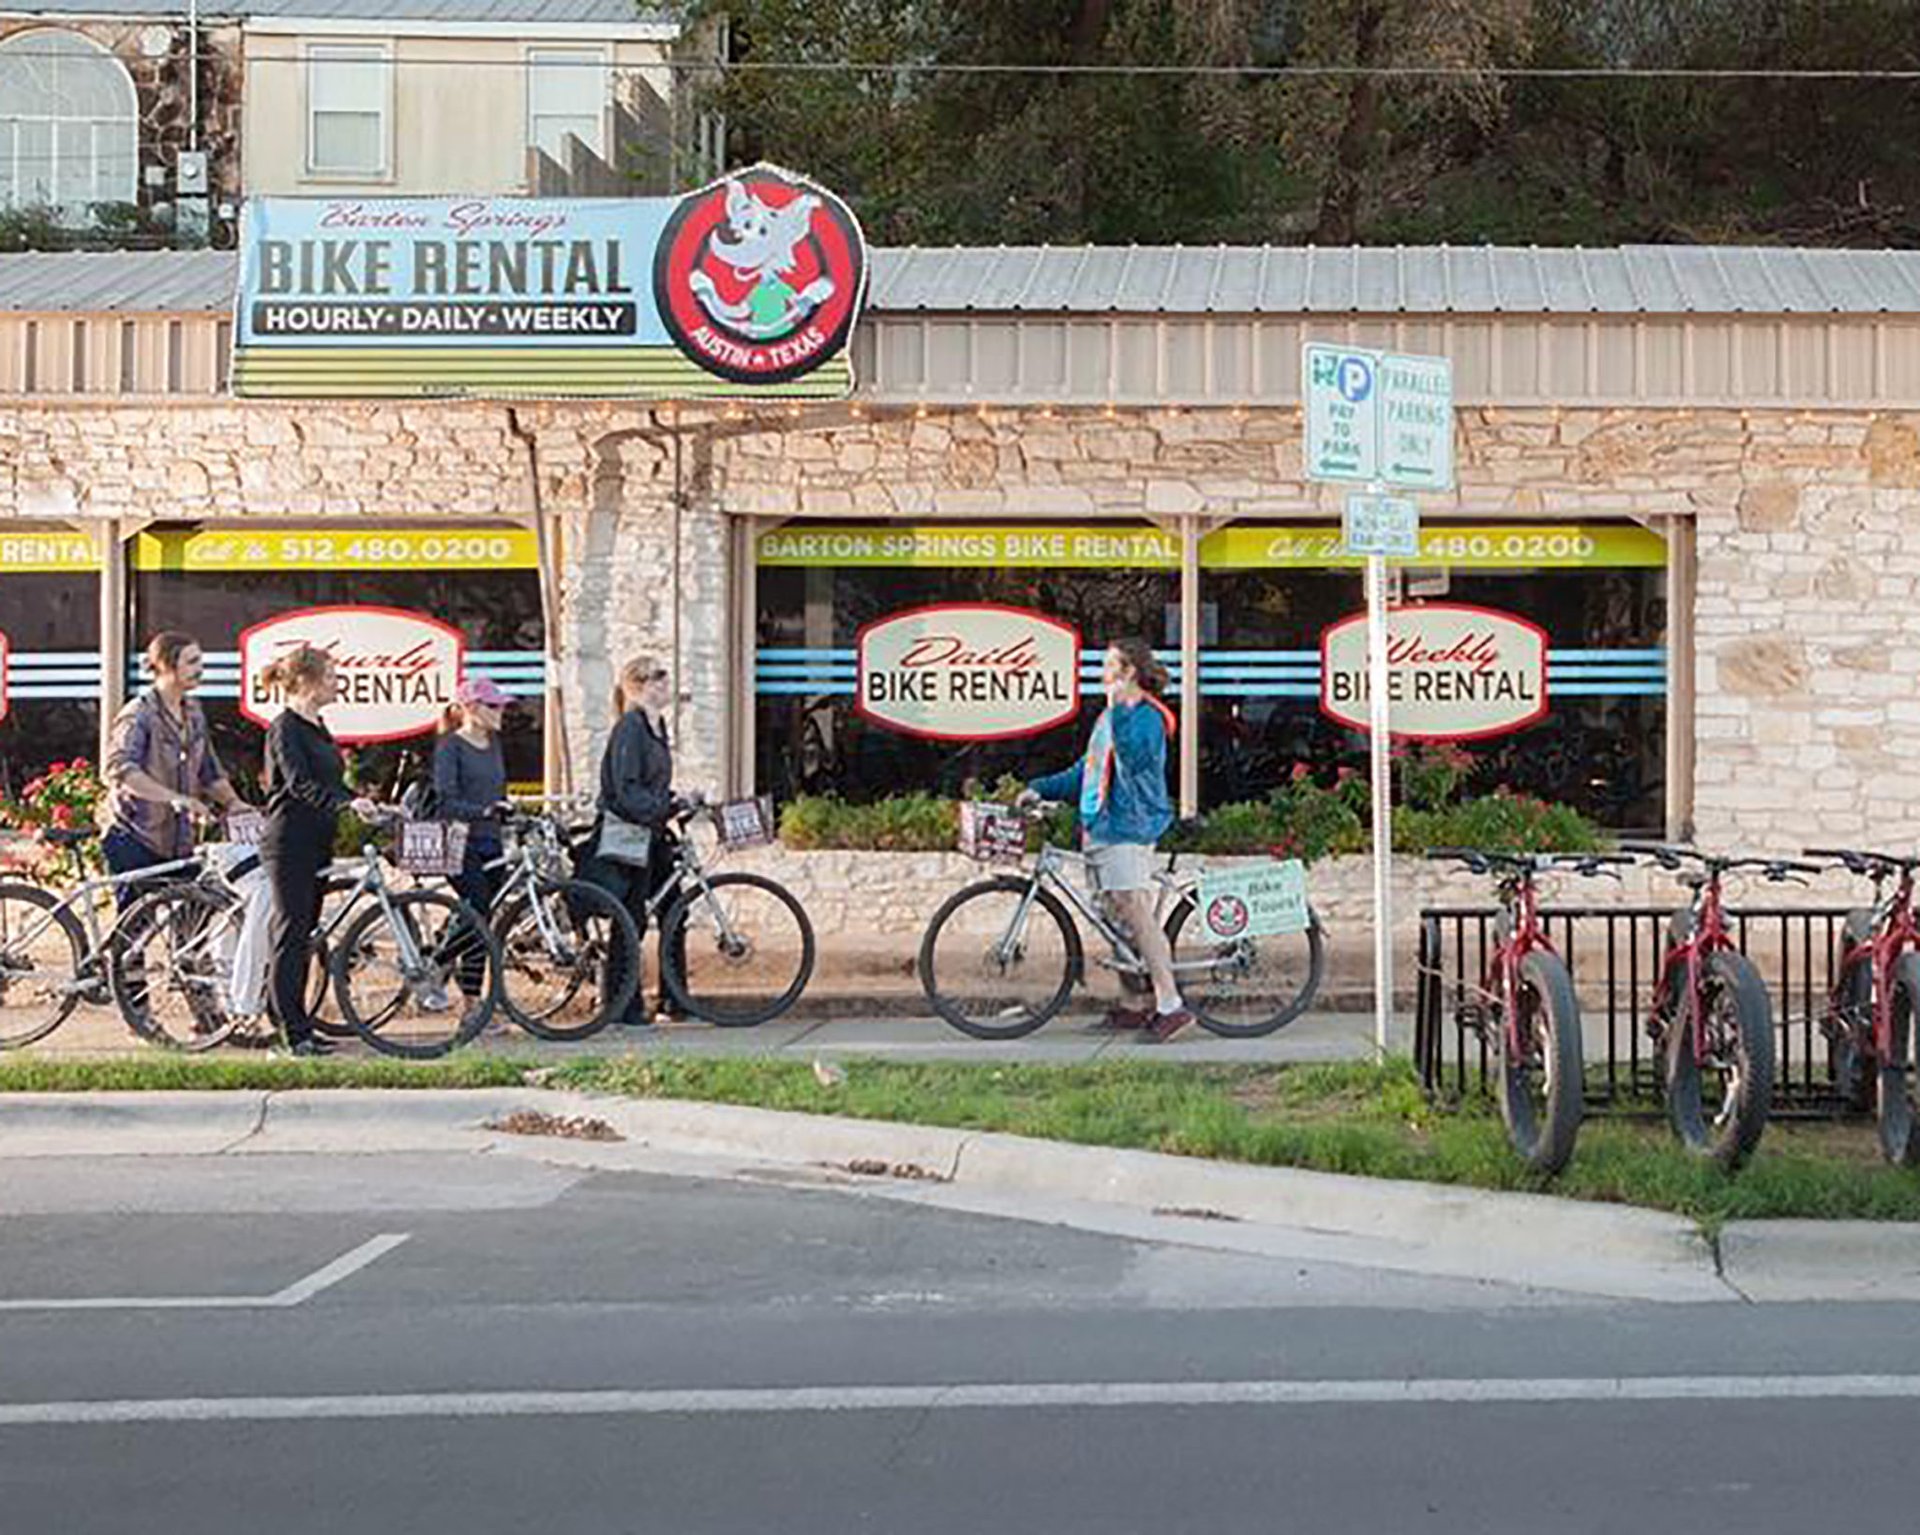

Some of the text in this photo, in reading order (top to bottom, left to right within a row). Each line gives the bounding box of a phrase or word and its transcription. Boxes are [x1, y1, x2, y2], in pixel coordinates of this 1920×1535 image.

[319, 202, 567, 237] Barton Springs
[257, 240, 632, 294] BIKE RENTAL
[266, 308, 624, 331] HOURLY DAILY WEEKLY
[691, 326, 825, 367] AUSTIN TEXAS
[1329, 404, 1356, 419] PAY
[1332, 423, 1350, 437] TO
[1322, 440, 1361, 457] PARK
[281, 537, 511, 563] 512.480.0200
[762, 534, 1179, 557] BARTON SPRINGS BIKE RENTAL
[901, 636, 1042, 668] Daily
[1367, 632, 1499, 672] Weekly
[335, 673, 450, 704] RENTAL
[868, 671, 1068, 702] BIKE RENTAL
[1415, 670, 1534, 702] RENTAL
